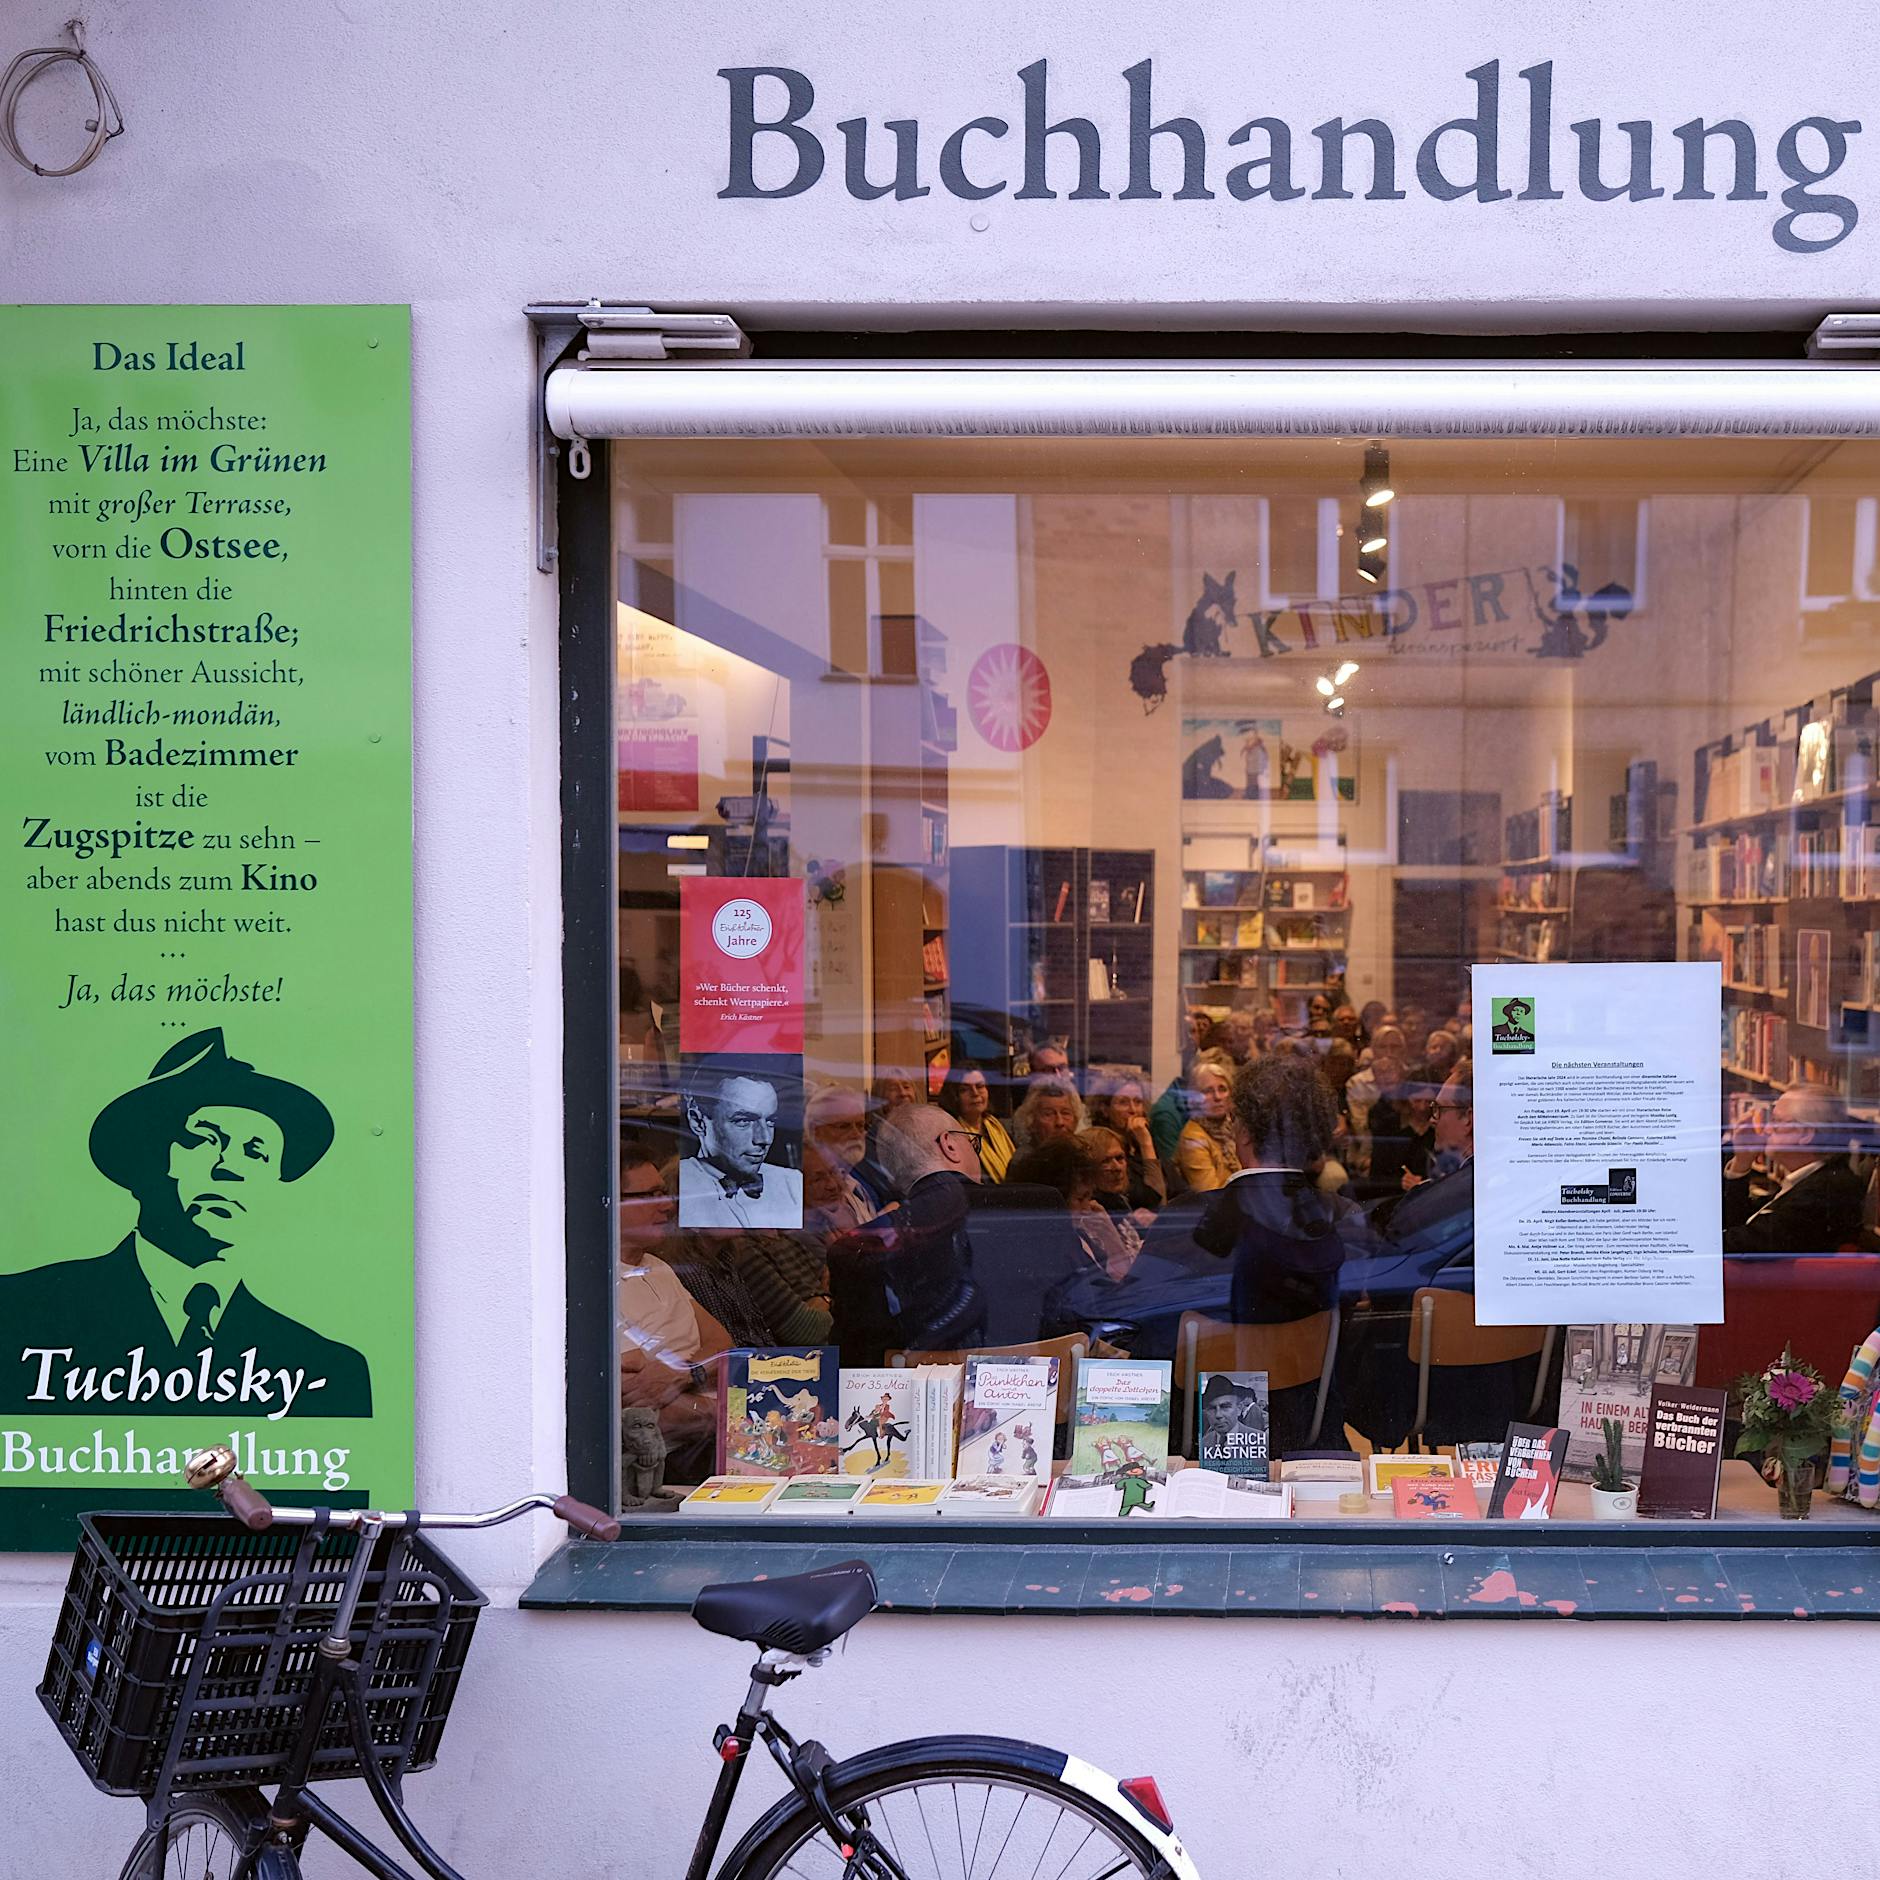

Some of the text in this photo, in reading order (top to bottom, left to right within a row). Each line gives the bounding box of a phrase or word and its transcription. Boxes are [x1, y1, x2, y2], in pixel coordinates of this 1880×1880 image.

[716, 58, 1863, 253] Buchhandlung
[93, 341, 245, 371] Das Ideal
[69, 406, 266, 437] Ja, das möchste:
[13, 443, 327, 472] Eine Villa im Grünen
[49, 490, 290, 523] mit großer Terrasse,
[53, 527, 287, 562] vorn die Ostsee,
[110, 576, 232, 600] hinten die
[1249, 572, 1510, 658] KINDER
[44, 613, 298, 647] Friedrichstraße;
[40, 659, 303, 686] mit schöner Aussicht,
[63, 700, 280, 727] ländlich-mondän,
[45, 738, 298, 767] vom Badezimmer
[136, 784, 208, 807] ist die
[23, 817, 194, 859] Zugspitze
[203, 835, 231, 850] zu
[240, 825, 295, 849] sehn
[27, 864, 317, 891] aber abends zum Kino
[56, 908, 291, 932] hast dus nicht weit.
[734, 909, 751, 920] 125
[727, 935, 757, 948] Jahre
[58, 973, 283, 1009] Ja, das möchste!
[696, 983, 788, 993] »Wer Bücher schenkt,
[694, 997, 789, 1008] schenkt Wertpapiere.«
[1593, 1061, 1644, 1069] Veranstaltungen
[21, 1346, 328, 1420] Tucholsky-
[846, 1380, 909, 1390] Der 35. Mai
[984, 1389, 1031, 1399] Anton
[1582, 1401, 1592, 1414] IN
[1596, 1402, 1630, 1417] EINEM
[1657, 1410, 1718, 1426] Das Buch der
[1658, 1400, 1720, 1413] Volker Weidermann
[1580, 1416, 1602, 1430] HAU
[1656, 1422, 1717, 1437] verbrannten
[1227, 1432, 1266, 1445] ERICH
[1512, 1436, 1546, 1449] ÜBER DAS
[1654, 1431, 1716, 1454] Bücher
[1, 1429, 351, 1491] Buchhalung
[1204, 1444, 1267, 1459] KÄSTNER
[1508, 1456, 1522, 1468] VON
[1510, 1447, 1552, 1460] VERBRENNEN
[1505, 1466, 1538, 1480] BÜCHERN
